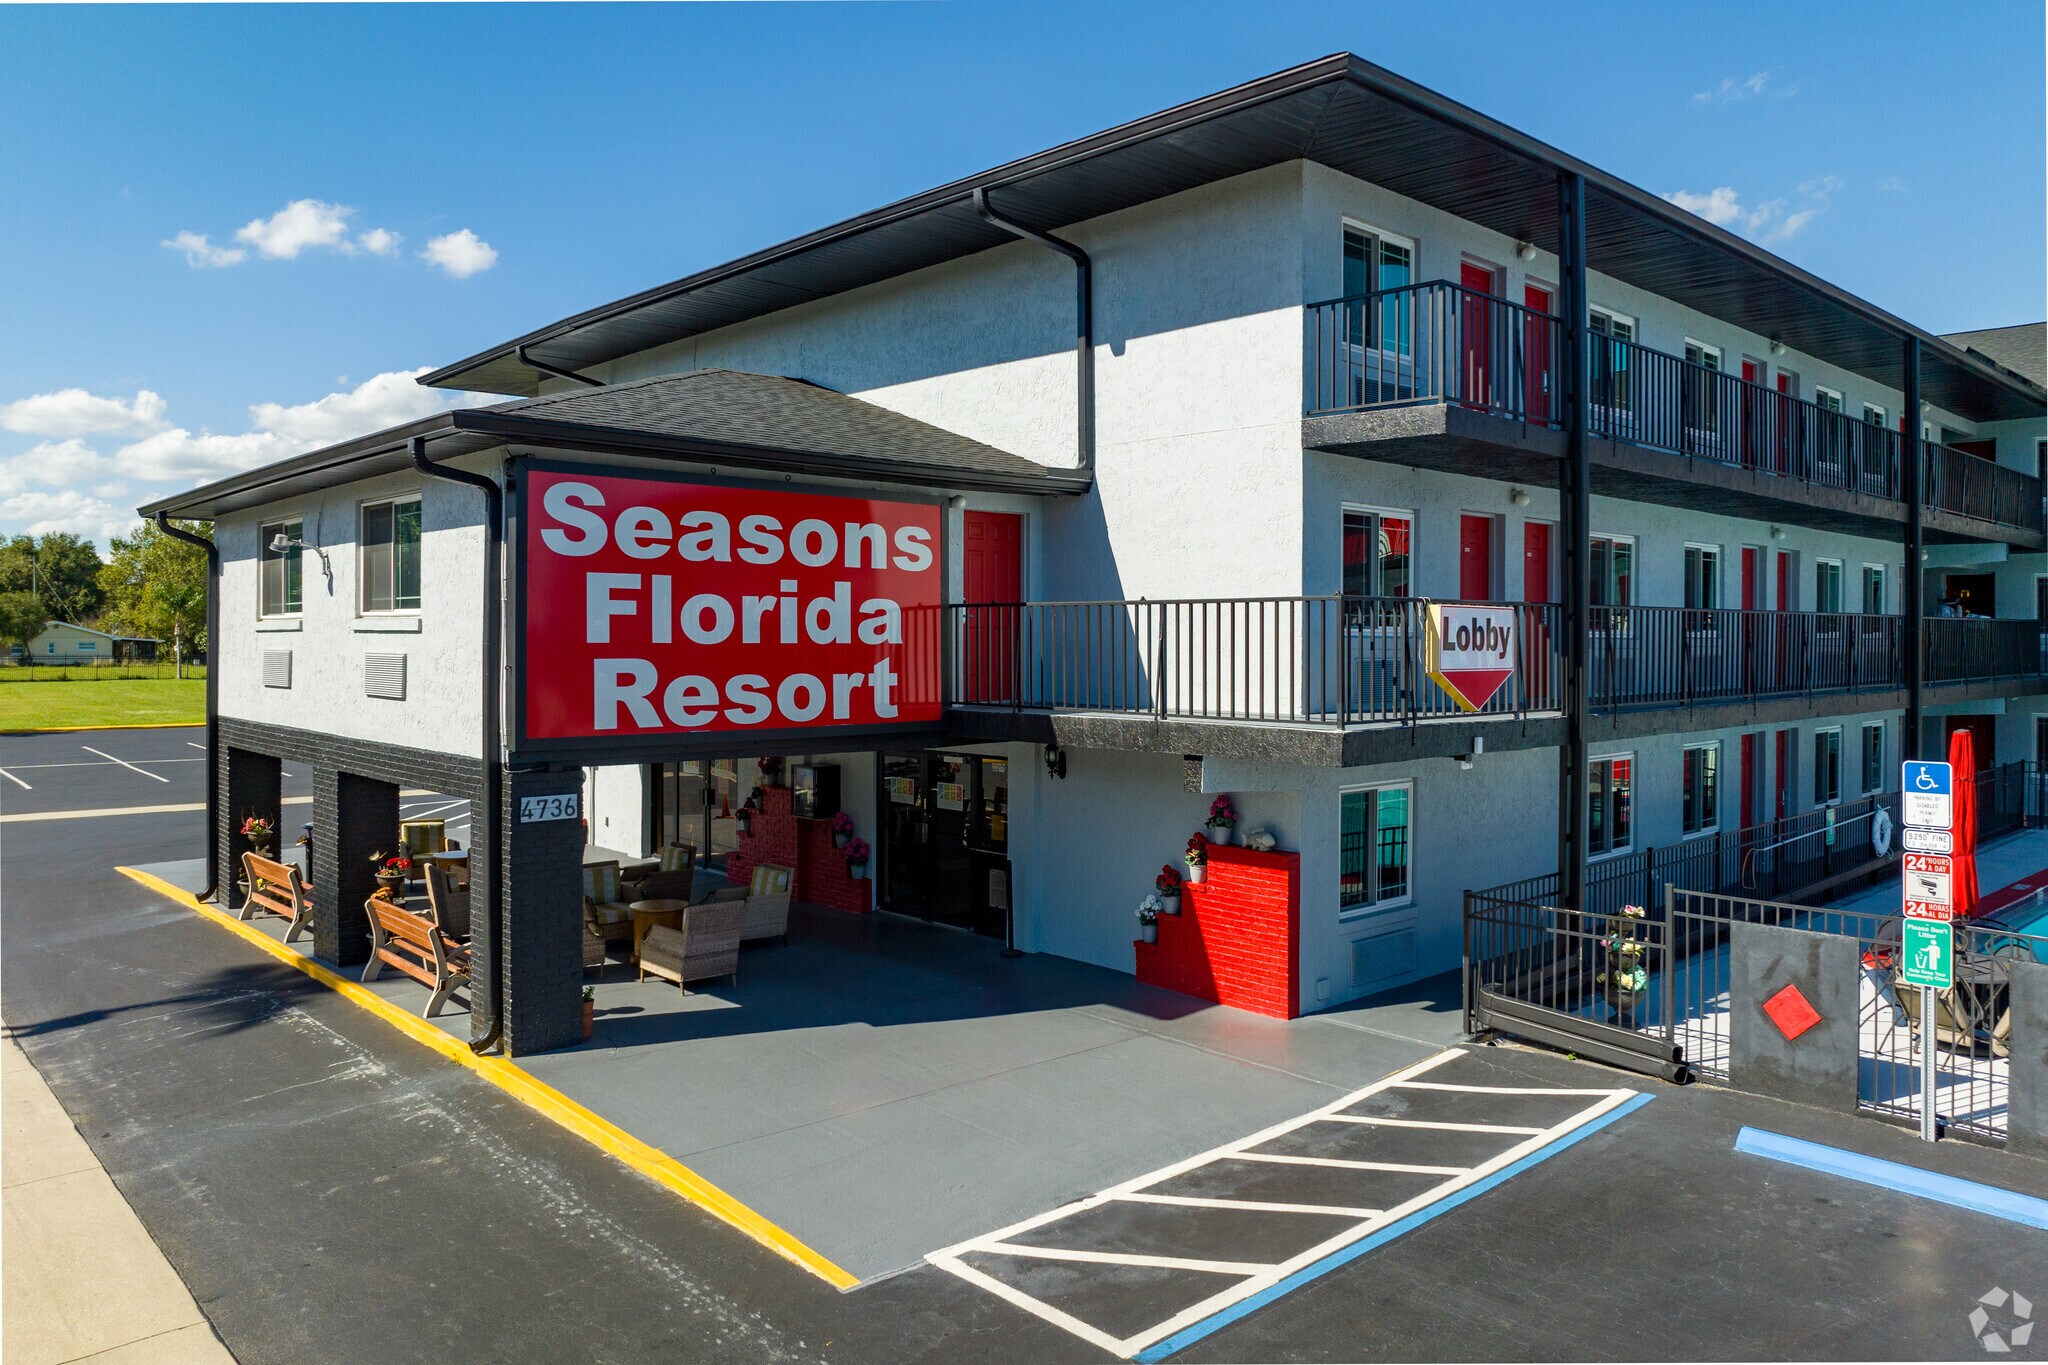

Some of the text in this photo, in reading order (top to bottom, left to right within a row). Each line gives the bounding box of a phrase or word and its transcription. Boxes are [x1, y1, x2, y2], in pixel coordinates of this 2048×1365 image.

[540, 481, 933, 572] Seasons
[586, 572, 903, 645] Florida
[1443, 617, 1511, 659] Lobby
[594, 656, 899, 730] Resort
[521, 797, 576, 820] 4736
[1932, 835, 1947, 843] FINE
[1906, 855, 1950, 870] 24 HOURS
[1934, 865, 1947, 873] DAY
[1906, 901, 1950, 917] 24 HORAS
[1928, 910, 1949, 920] AL DIA
